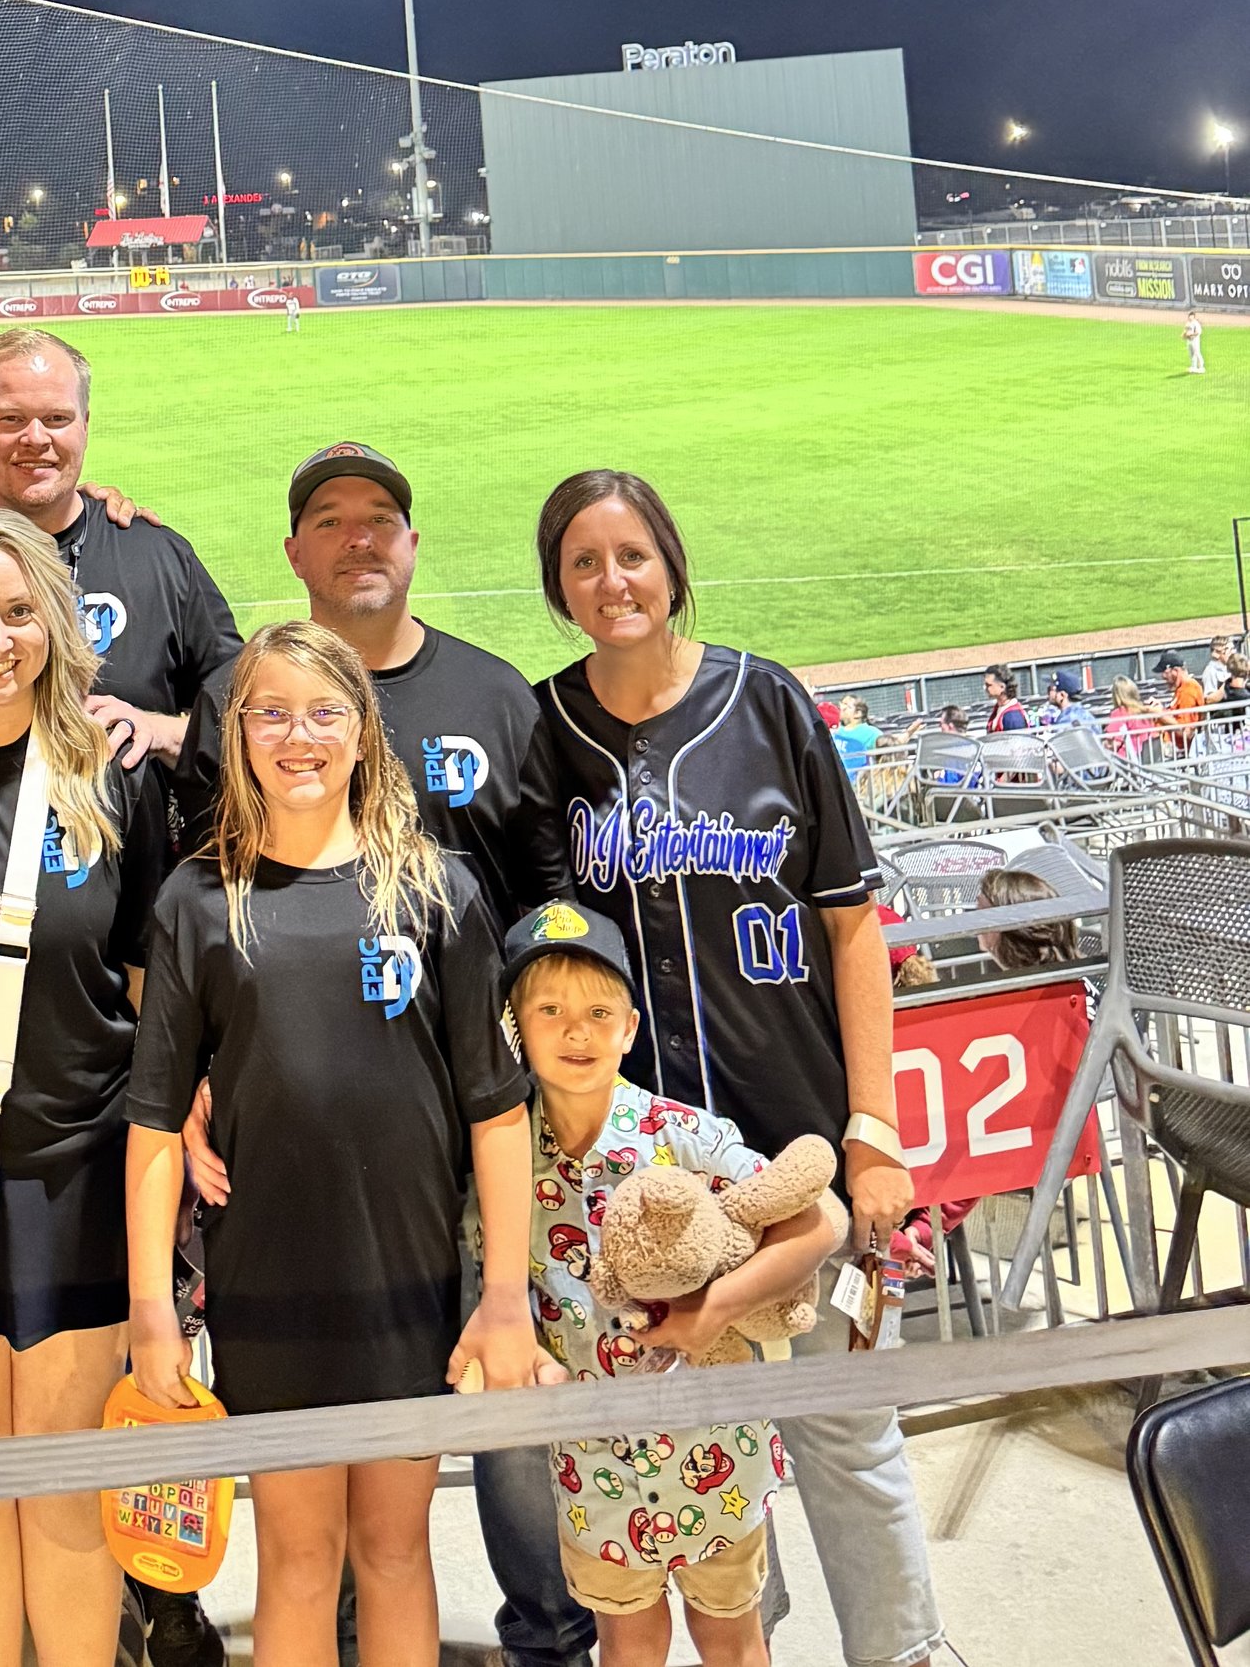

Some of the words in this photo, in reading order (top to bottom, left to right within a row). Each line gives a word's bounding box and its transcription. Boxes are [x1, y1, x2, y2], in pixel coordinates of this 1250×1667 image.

[621, 40, 736, 71] Peraton
[930, 254, 995, 286] CGI
[1105, 258, 1134, 278] noblis
[254, 295, 287, 304] INTREPID
[1137, 278, 1176, 300] MISSION
[1194, 283, 1224, 298] MARX
[5, 303, 37, 312] INTREPID
[83, 300, 117, 309] INTREPID
[166, 297, 201, 307] INTREPID
[421, 736, 449, 793] EPIC
[567, 796, 627, 893] DJ
[622, 796, 797, 885] Entertainment
[731, 901, 811, 986] 01
[358, 937, 385, 1002] EPIC
[136, 1494, 147, 1509] T
[150, 1499, 160, 1514] U
[165, 1504, 176, 1518] V
[150, 1483, 163, 1495] O
[166, 1486, 177, 1499] P
[196, 1496, 206, 1509] R
[118, 1509, 131, 1523] W
[134, 1513, 146, 1527] X
[149, 1518, 159, 1532] Y
[163, 1523, 174, 1536] Z
